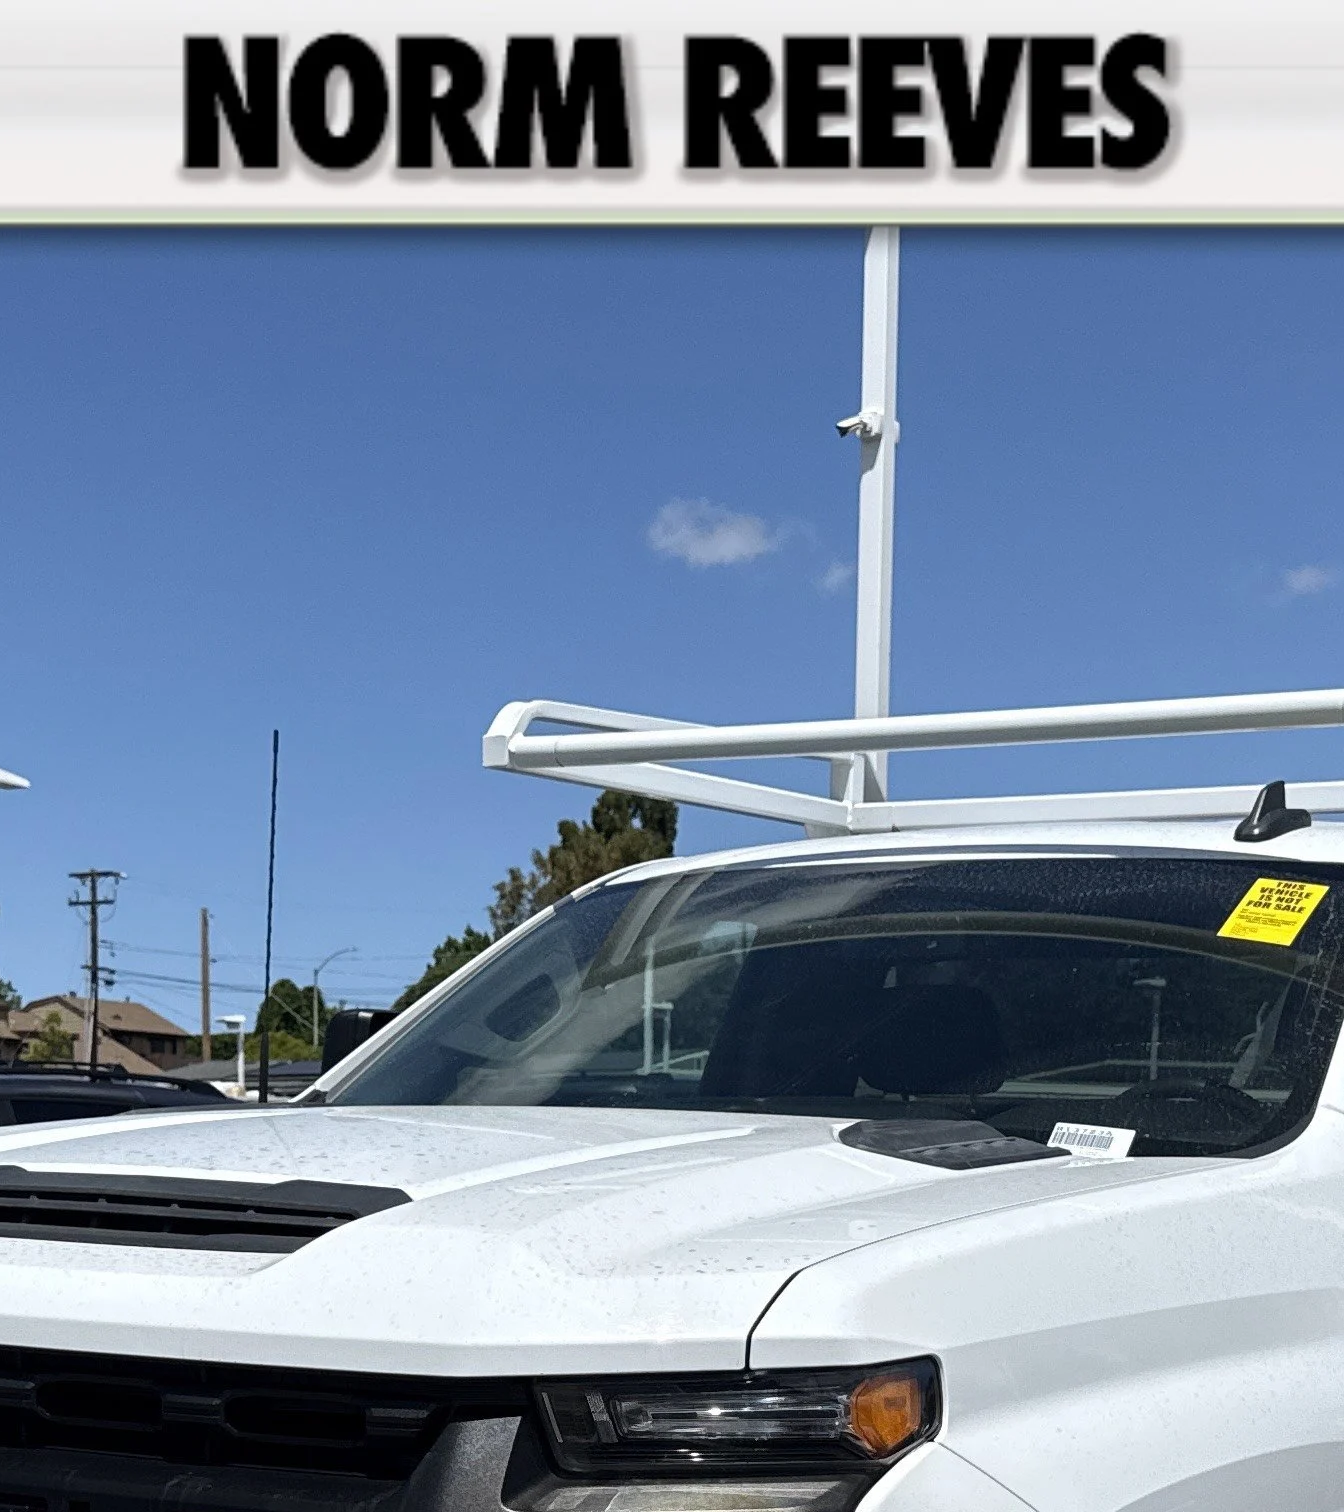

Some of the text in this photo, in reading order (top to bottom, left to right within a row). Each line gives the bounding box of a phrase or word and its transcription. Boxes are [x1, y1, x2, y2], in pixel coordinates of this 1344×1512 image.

[1275, 881, 1307, 891] THIS
[1259, 886, 1313, 900] VEHICLE
[1245, 899, 1272, 910] FOR
[1273, 903, 1307, 914] SALE
[1258, 894, 1304, 906] IS NOT
